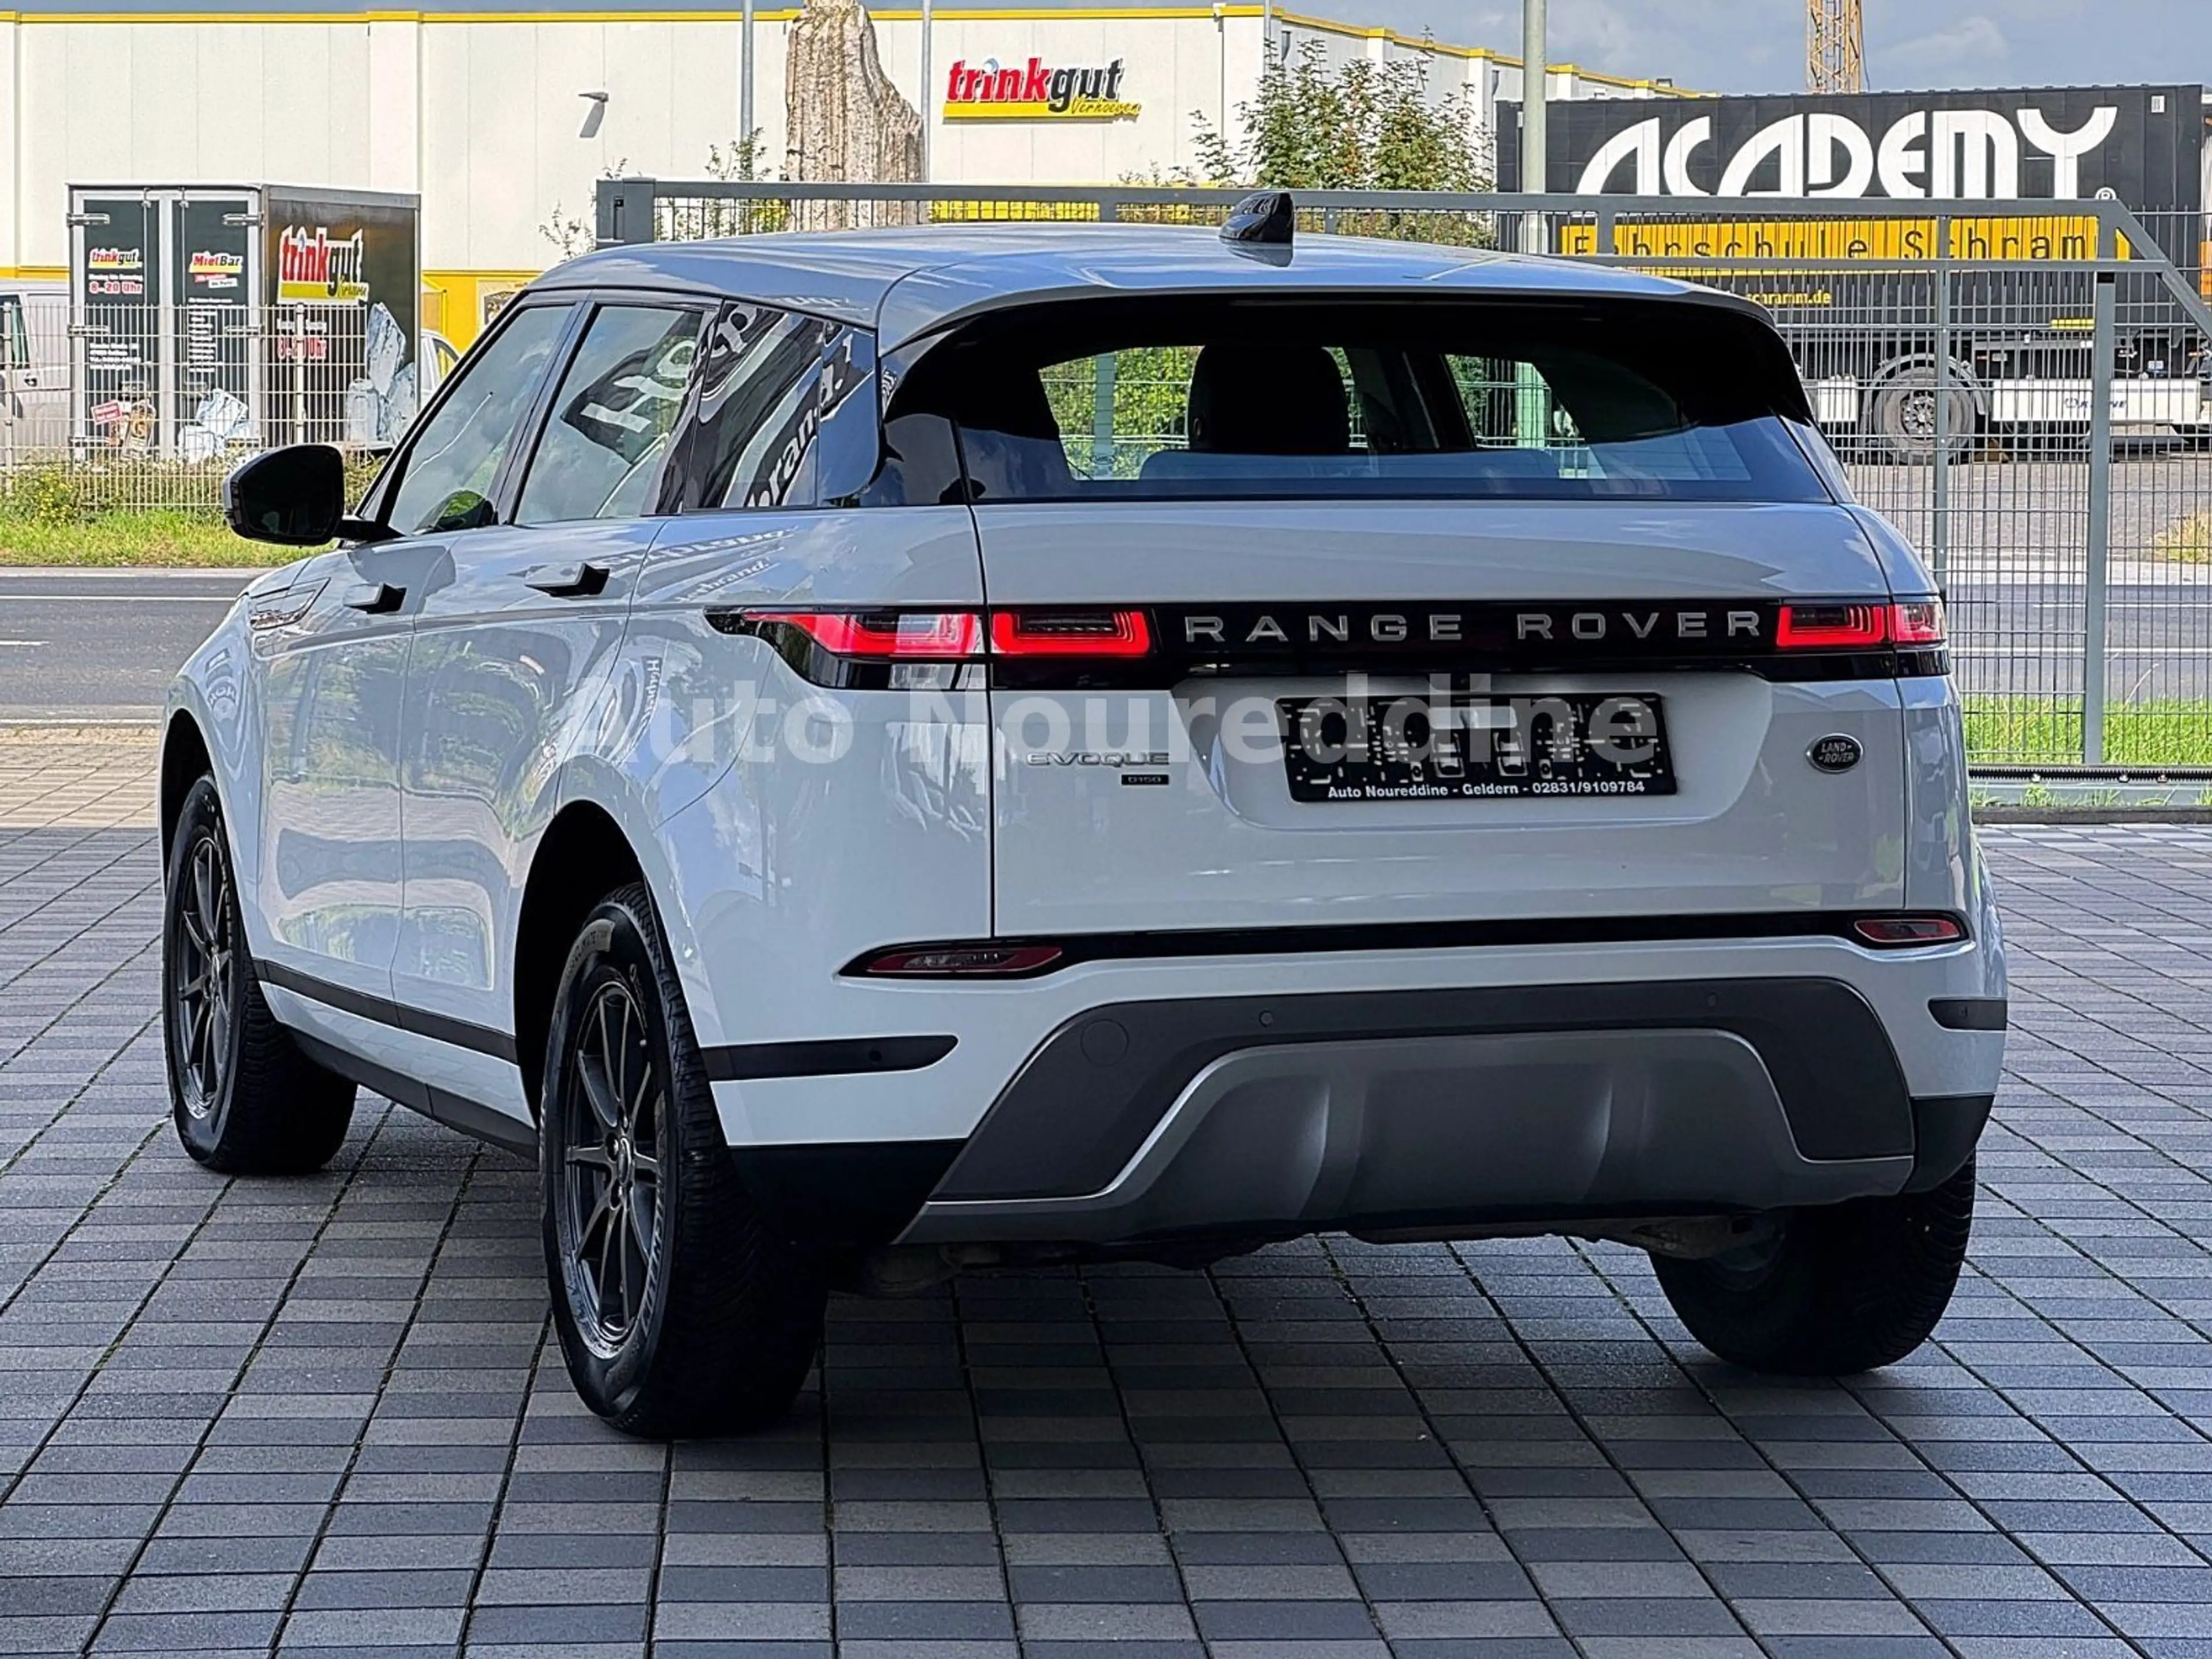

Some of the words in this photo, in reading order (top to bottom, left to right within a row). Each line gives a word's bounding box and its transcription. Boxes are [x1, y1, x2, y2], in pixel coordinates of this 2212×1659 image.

[946, 56, 1124, 113] trinkgut
[1575, 106, 2118, 199] ACADEMY
[1575, 229, 1868, 257] Fhrschule
[282, 233, 361, 297] trinkgut
[1184, 615, 1462, 643] RANGE
[1516, 611, 1760, 640] ROVER
[1026, 752, 1171, 768] EVOQUE
[1821, 742, 1847, 753] LAND
[1823, 752, 1855, 764] ROVER
[1328, 786, 1362, 798] Auto
[1365, 783, 1449, 798] Noureddine
[1462, 783, 1519, 796] Geldern
[1532, 781, 1645, 794] 02831/9109784
